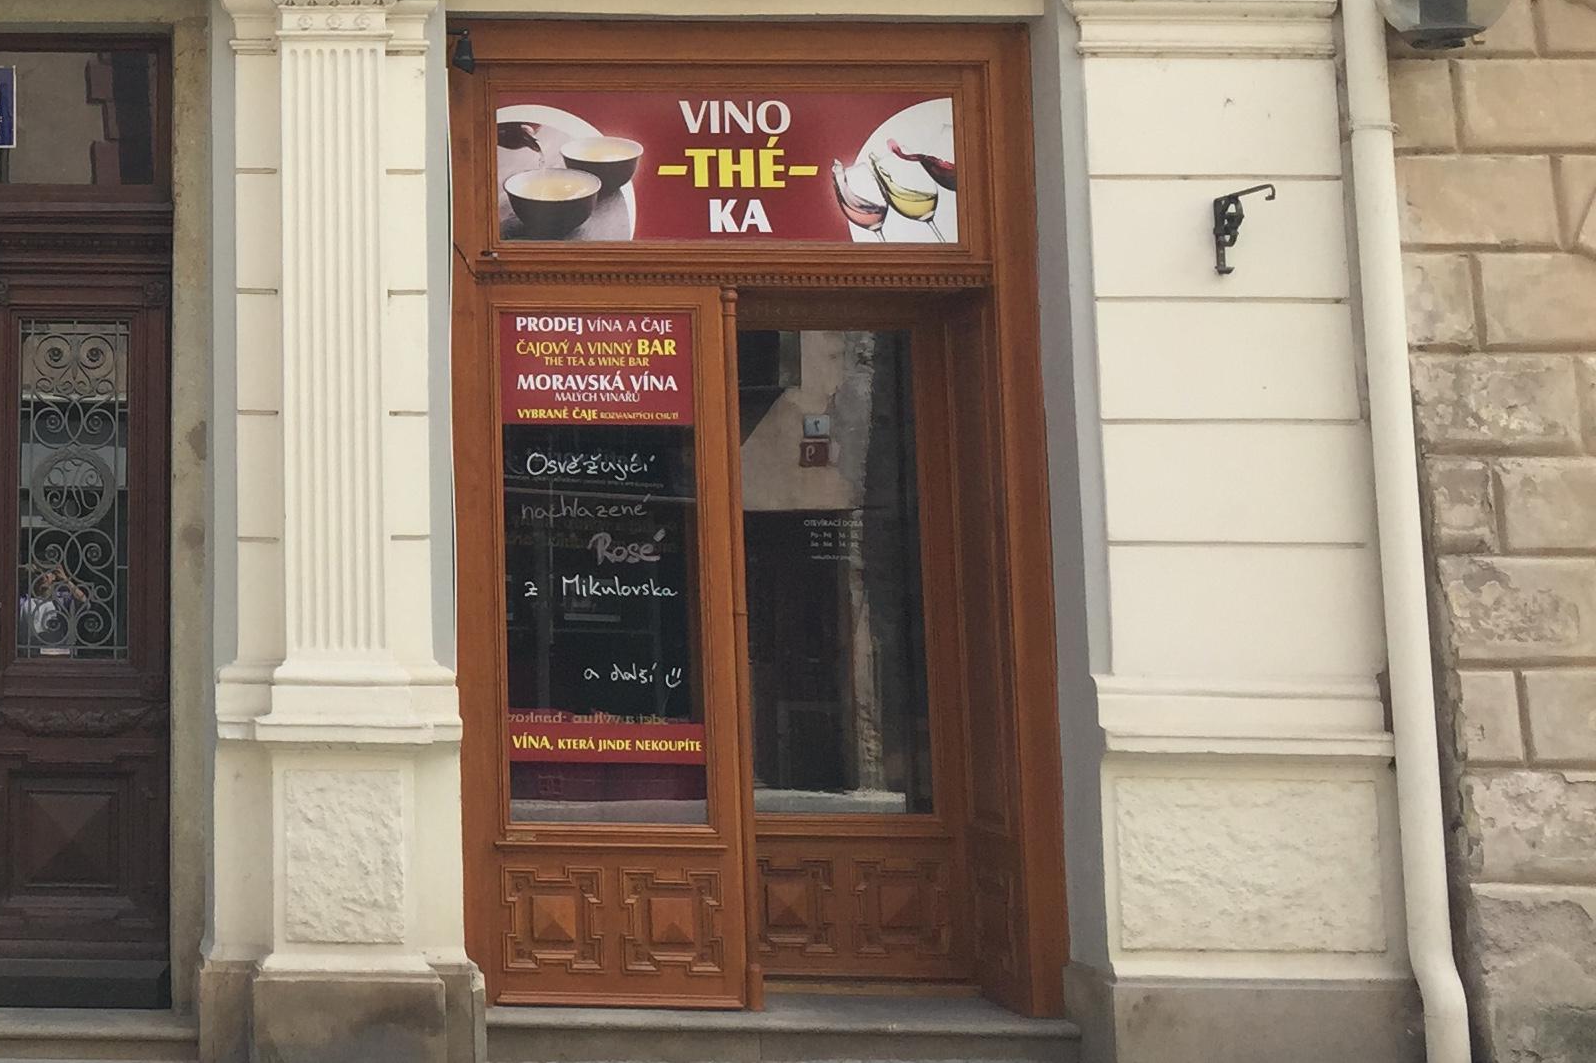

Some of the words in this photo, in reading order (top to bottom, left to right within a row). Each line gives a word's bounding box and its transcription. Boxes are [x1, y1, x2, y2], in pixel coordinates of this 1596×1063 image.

[678, 100, 791, 135] VINO
[709, 198, 773, 233] KA
[516, 316, 583, 335] PRODEJ
[587, 317, 623, 332] VÍNA
[626, 319, 637, 332] A
[640, 317, 673, 335] ČAJE
[516, 338, 570, 357] ČAJOVÝ
[573, 342, 584, 355] A
[587, 339, 633, 355] VINNÝ
[637, 339, 677, 356] BAR
[544, 356, 563, 366] THE
[567, 356, 585, 366] TEA
[588, 357, 595, 366] &
[598, 357, 625, 367] WINE
[628, 357, 650, 367] BAR
[517, 370, 625, 391] MORAVSKÁ
[629, 371, 678, 392] VÍNA
[555, 390, 597, 402] MALÝCH
[599, 390, 641, 402] VINAŘŮ
[517, 406, 569, 419] VYBRANÉ
[572, 406, 598, 420] ČAJE
[587, 528, 666, 565] Rosé
[562, 574, 678, 597] Mikulovska
[584, 668, 600, 680] a
[610, 662, 657, 684] další
[512, 732, 554, 750] VÍNA,
[557, 736, 595, 750] KTERÁ
[597, 739, 632, 752] JINDE
[635, 738, 702, 752] NEKOUPÍTE
